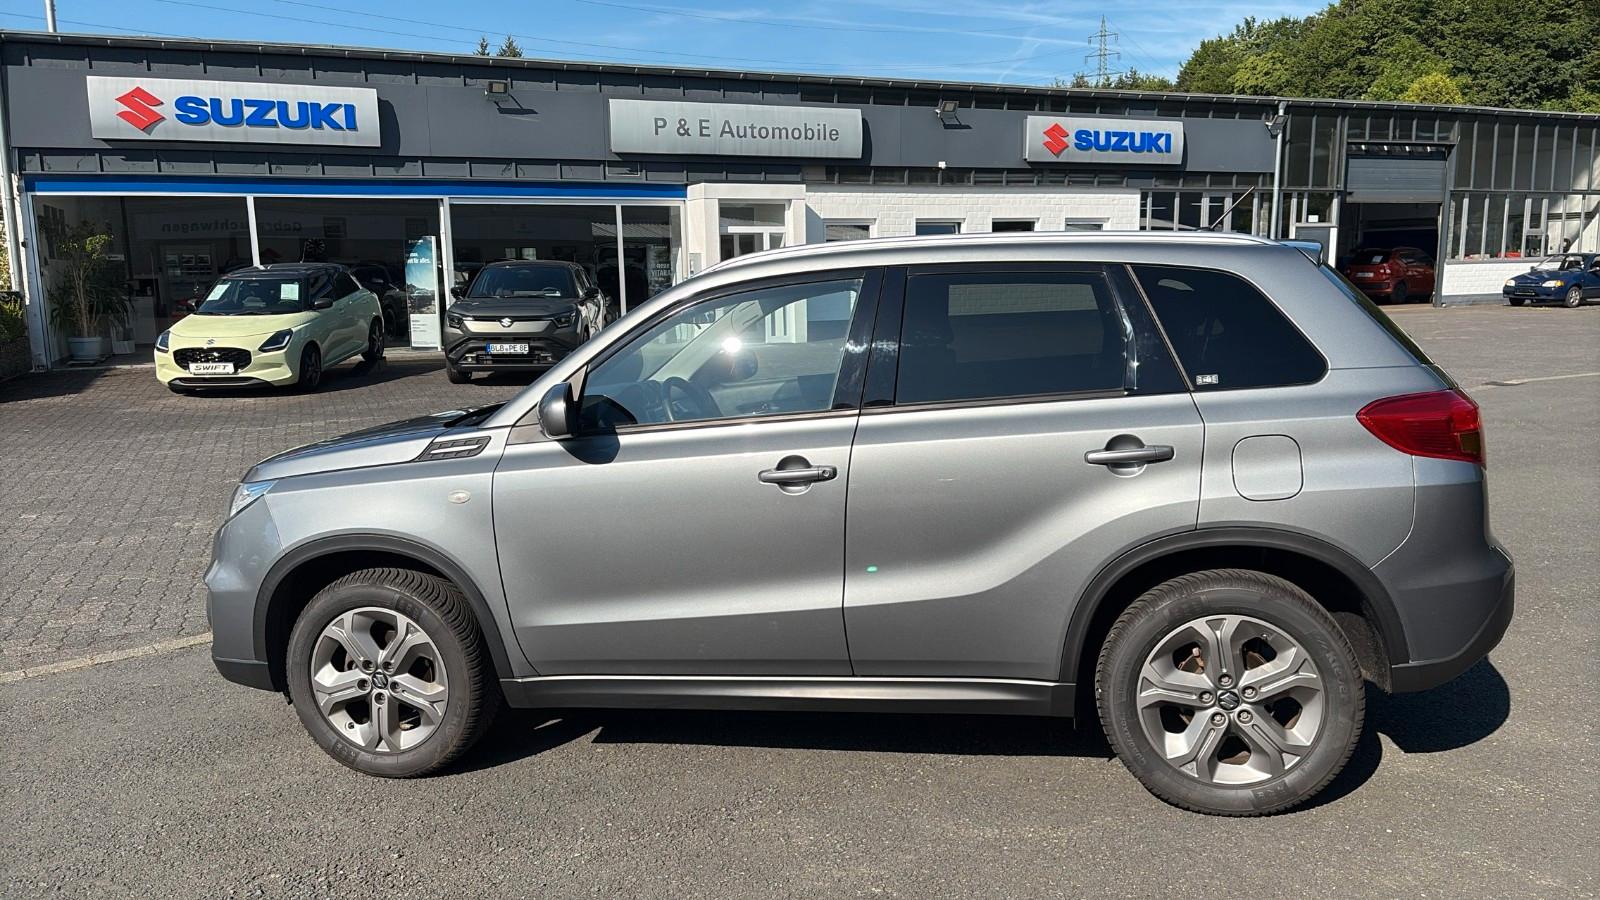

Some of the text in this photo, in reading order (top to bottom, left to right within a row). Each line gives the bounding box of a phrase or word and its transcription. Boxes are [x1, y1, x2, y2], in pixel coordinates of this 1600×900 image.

[174, 95, 357, 131] SUZUKI
[653, 117, 840, 142] P & E Automobile
[1074, 129, 1172, 154] SUZUKI
